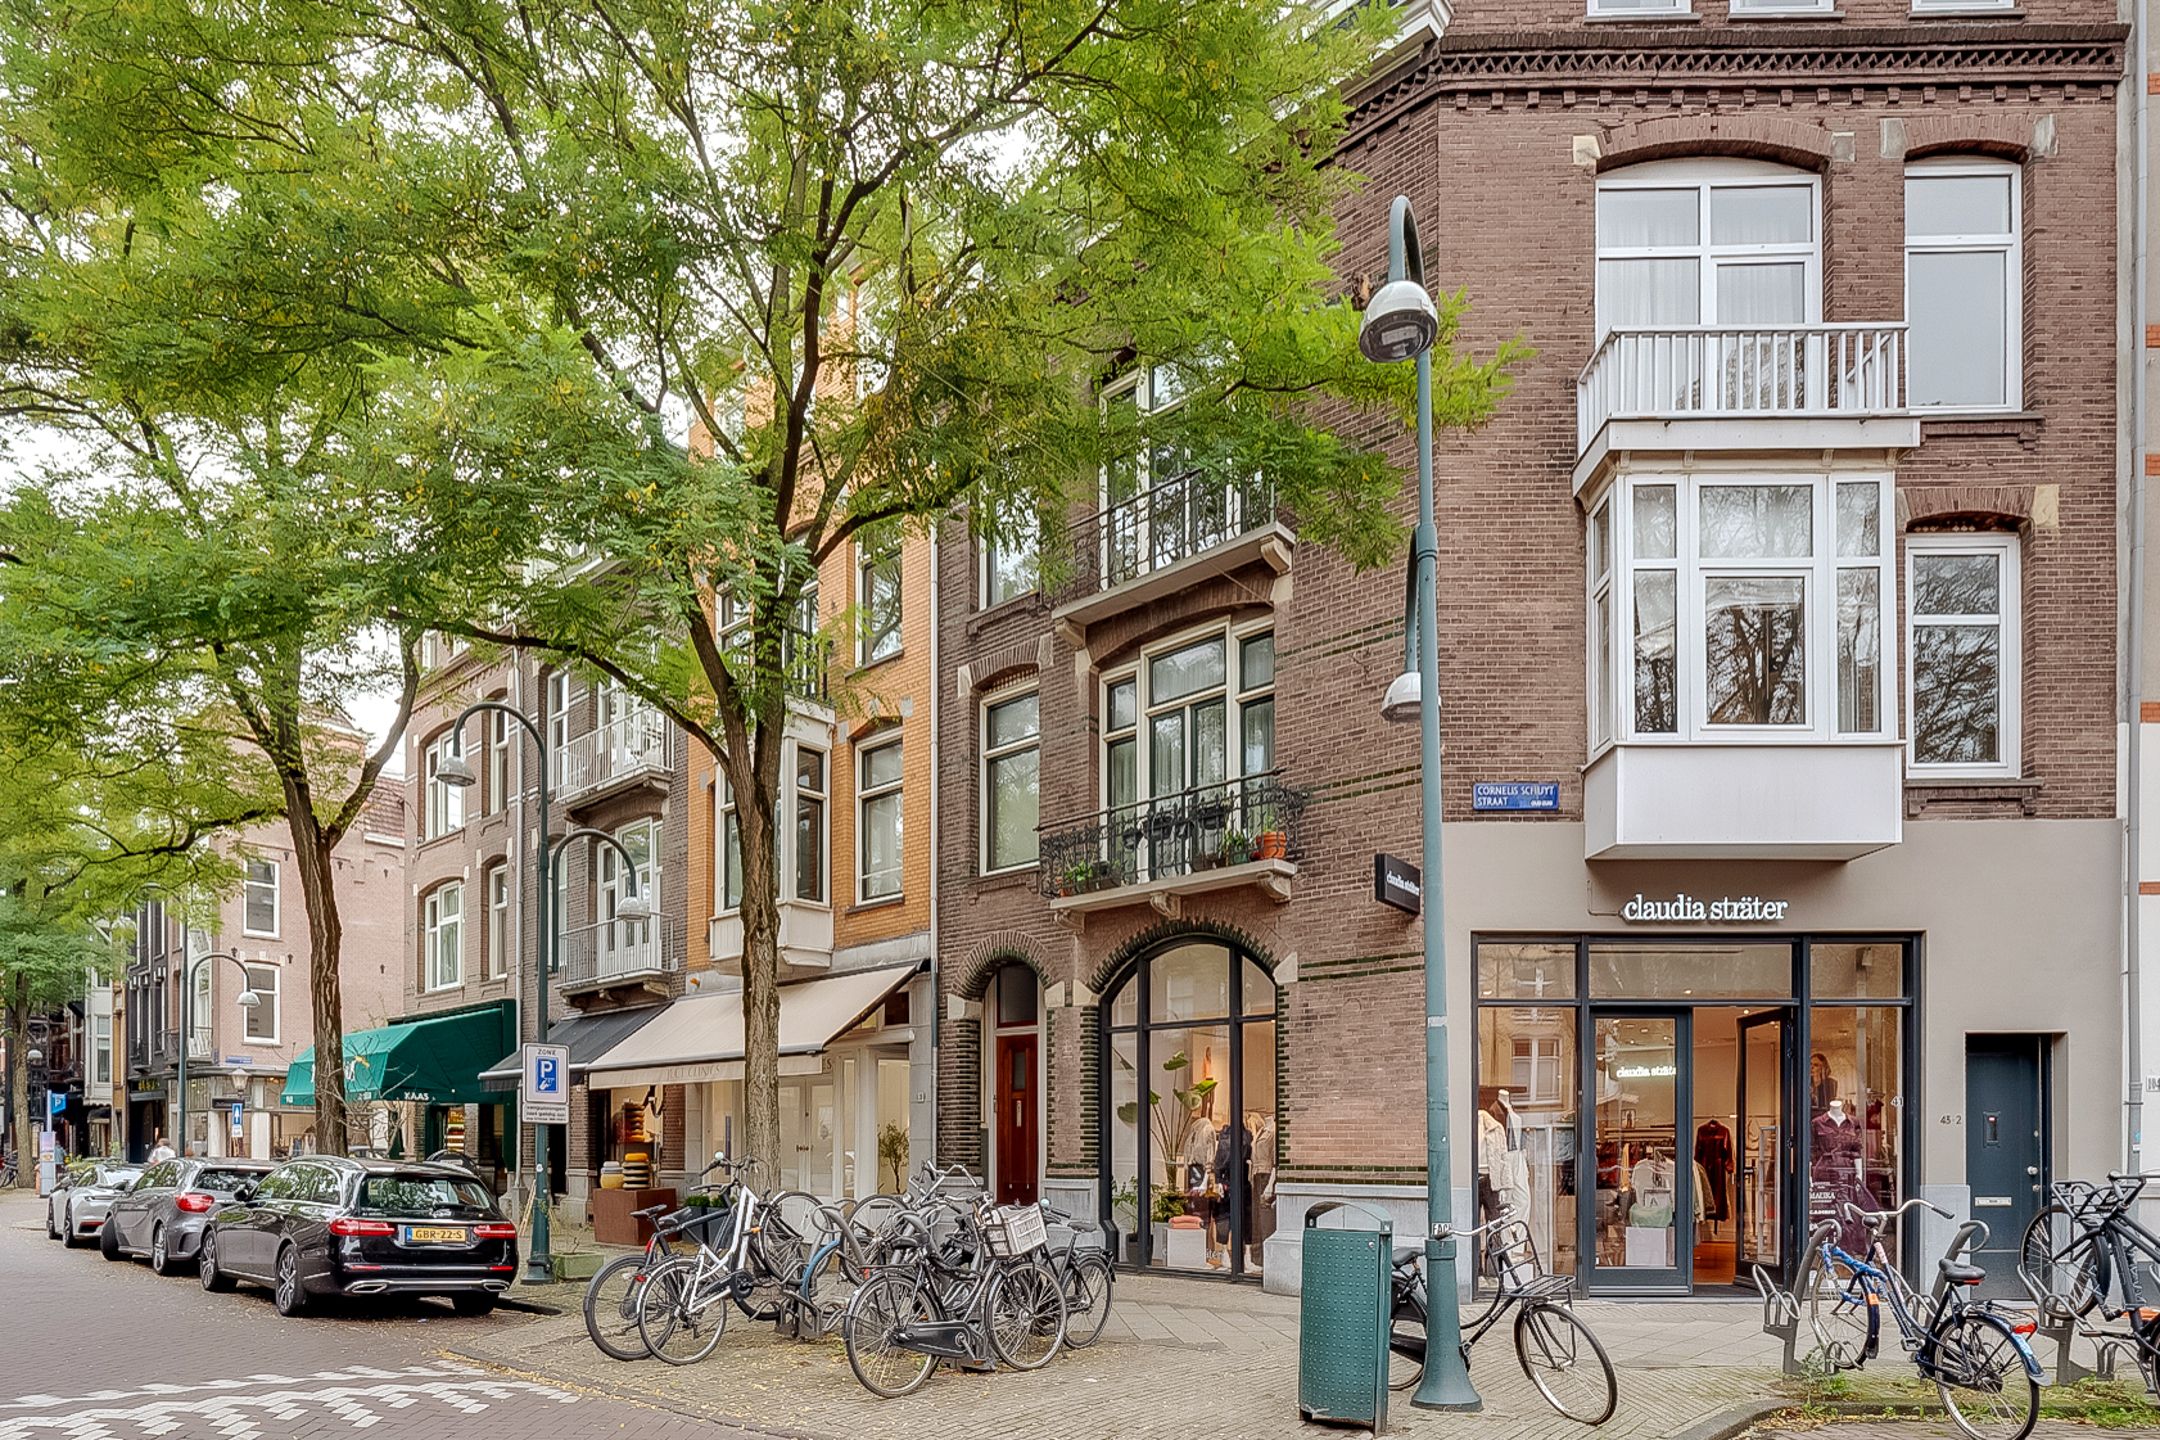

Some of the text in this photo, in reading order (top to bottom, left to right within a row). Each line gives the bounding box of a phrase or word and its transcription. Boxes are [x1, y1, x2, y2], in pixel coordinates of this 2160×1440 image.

[1477, 785, 1554, 796] CORNELIS SCHUYT
[1477, 796, 1508, 807] STRAAT
[1624, 894, 1788, 920] claudia sträter
[537, 1047, 556, 1056] ZONE
[540, 1060, 553, 1078] P
[415, 1230, 463, 1239] GBR-22-S
